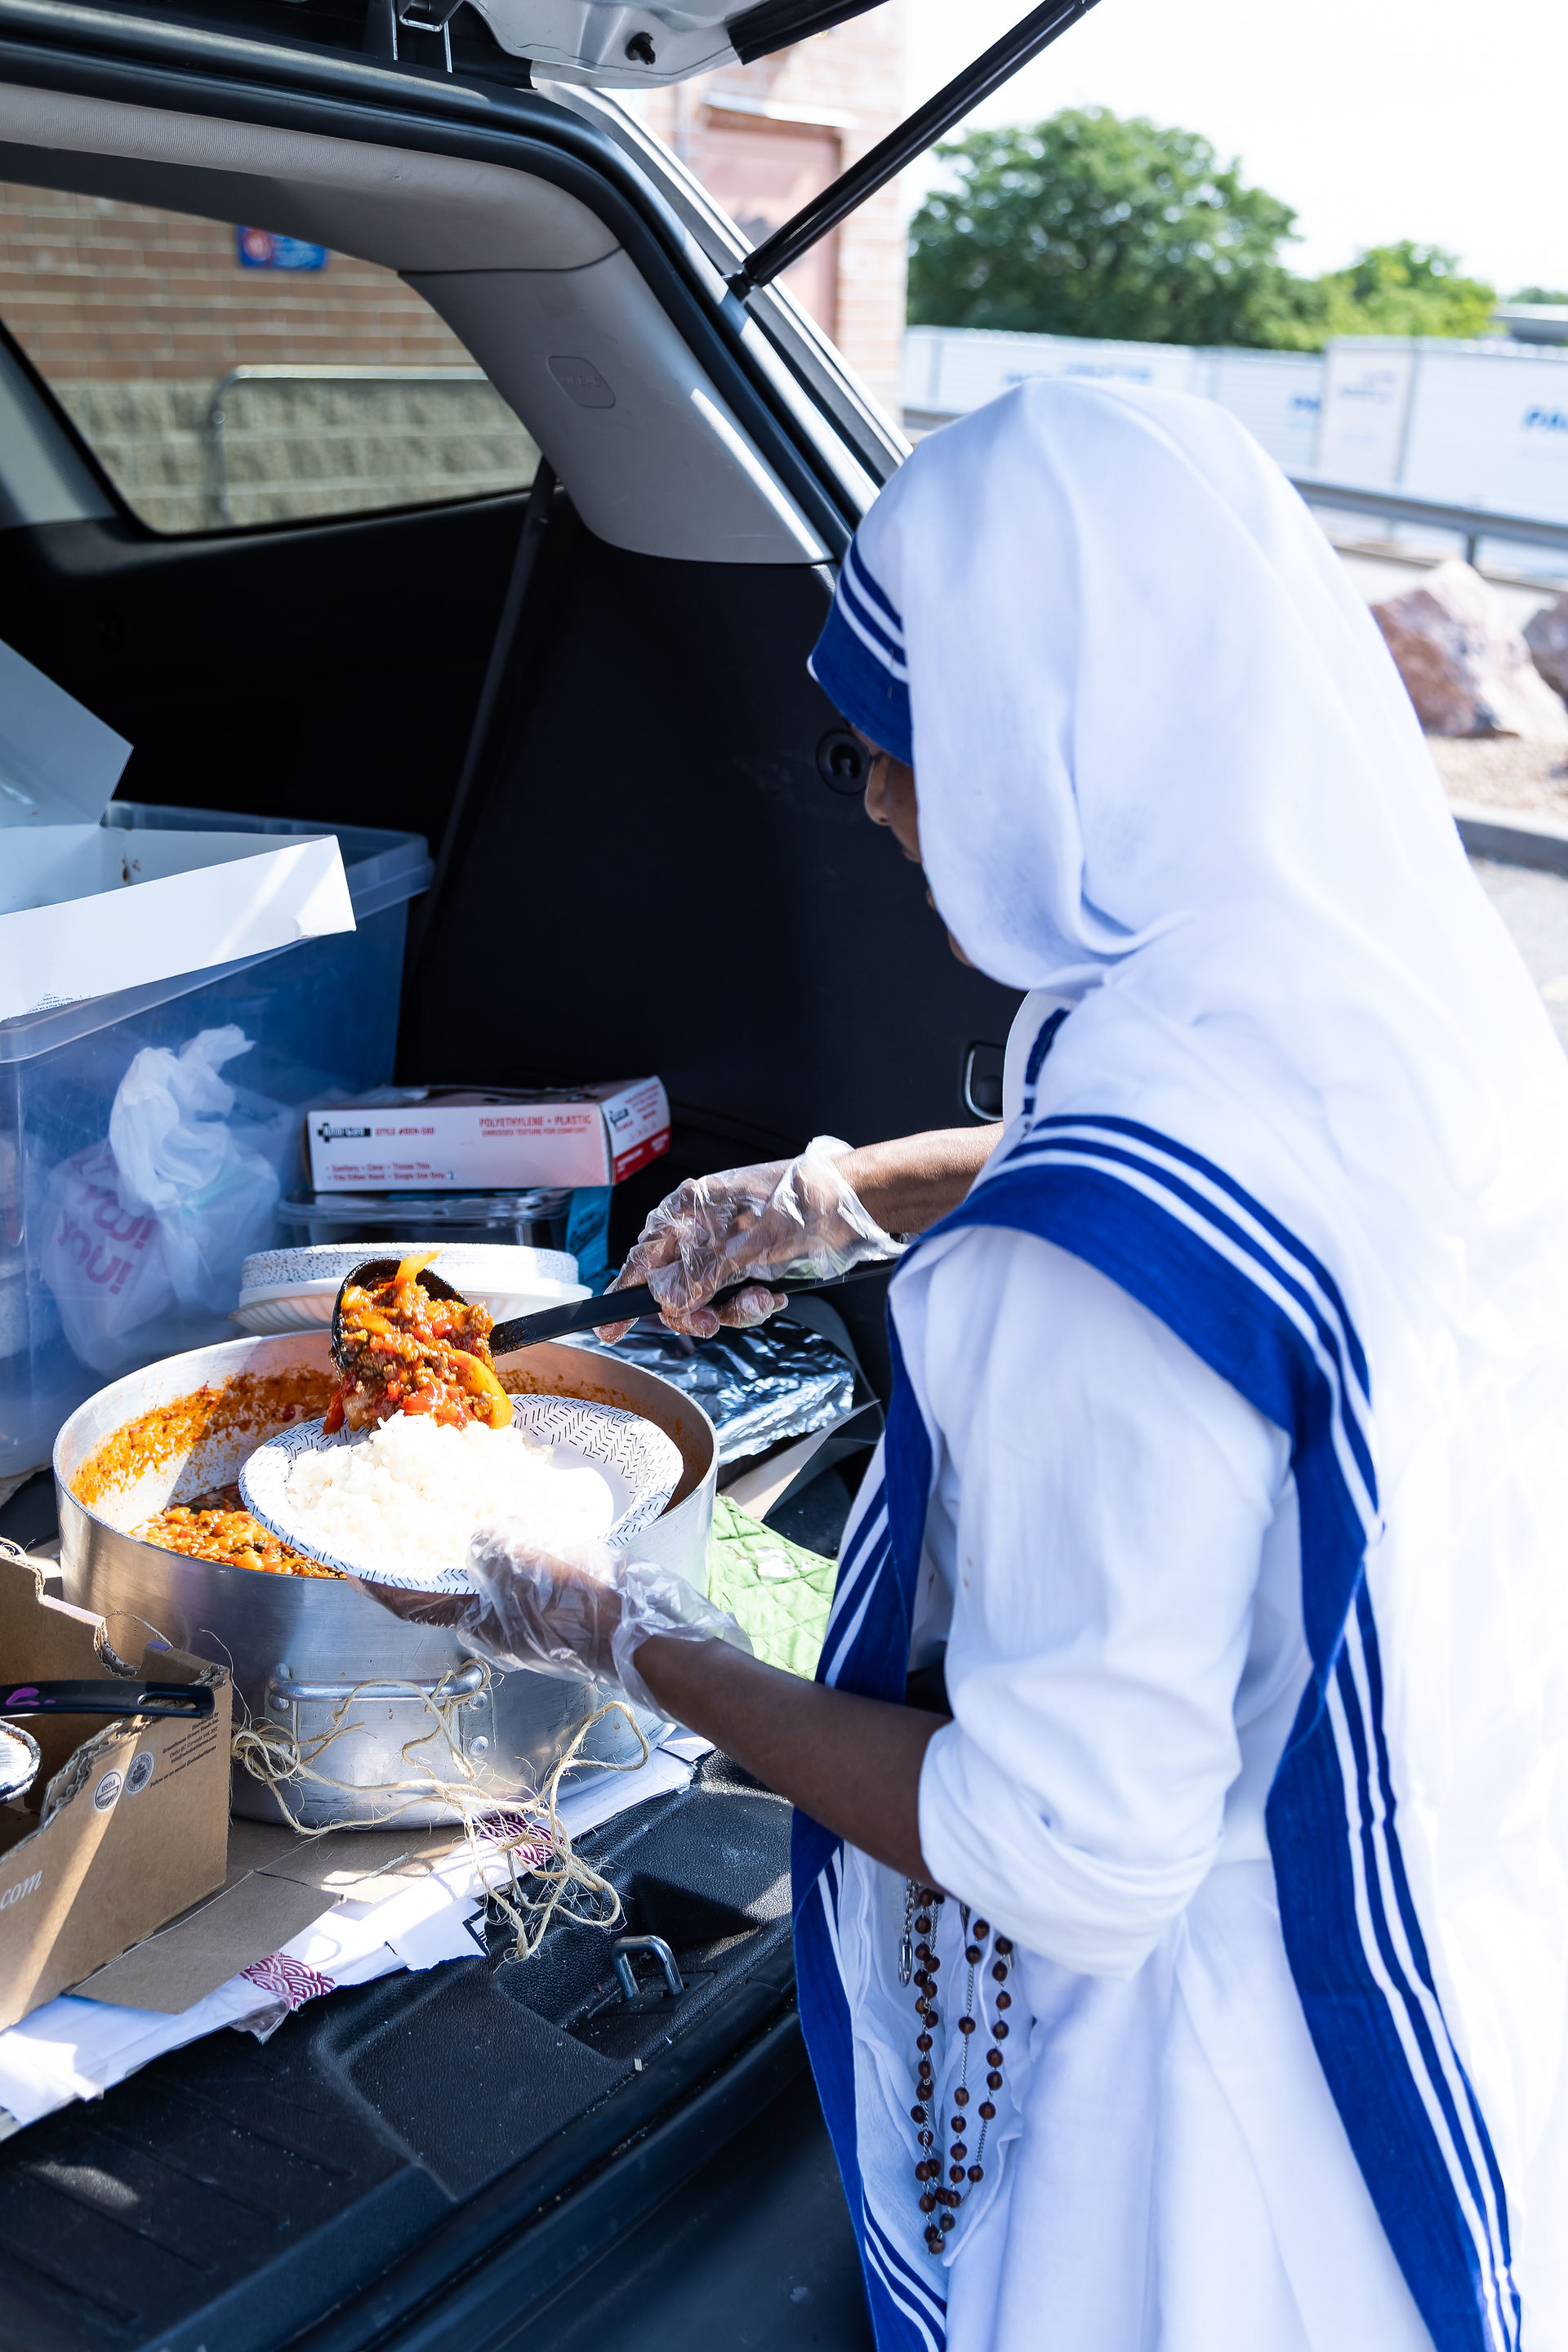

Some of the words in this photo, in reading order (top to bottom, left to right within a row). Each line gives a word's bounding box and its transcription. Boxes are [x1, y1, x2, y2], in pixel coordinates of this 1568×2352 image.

[479, 1116, 543, 1128] POLYETHYLENE
[554, 1114, 592, 1125] PLASTIC
[376, 1127, 396, 1136] STYLE
[163, 1737, 187, 1753] Greenhouse
[187, 1729, 200, 1740] Grown
[200, 1722, 212, 1731] Foods
[150, 1777, 163, 1788] Follow
[174, 1762, 186, 1774] social
[101, 1779, 116, 1793] USDA
